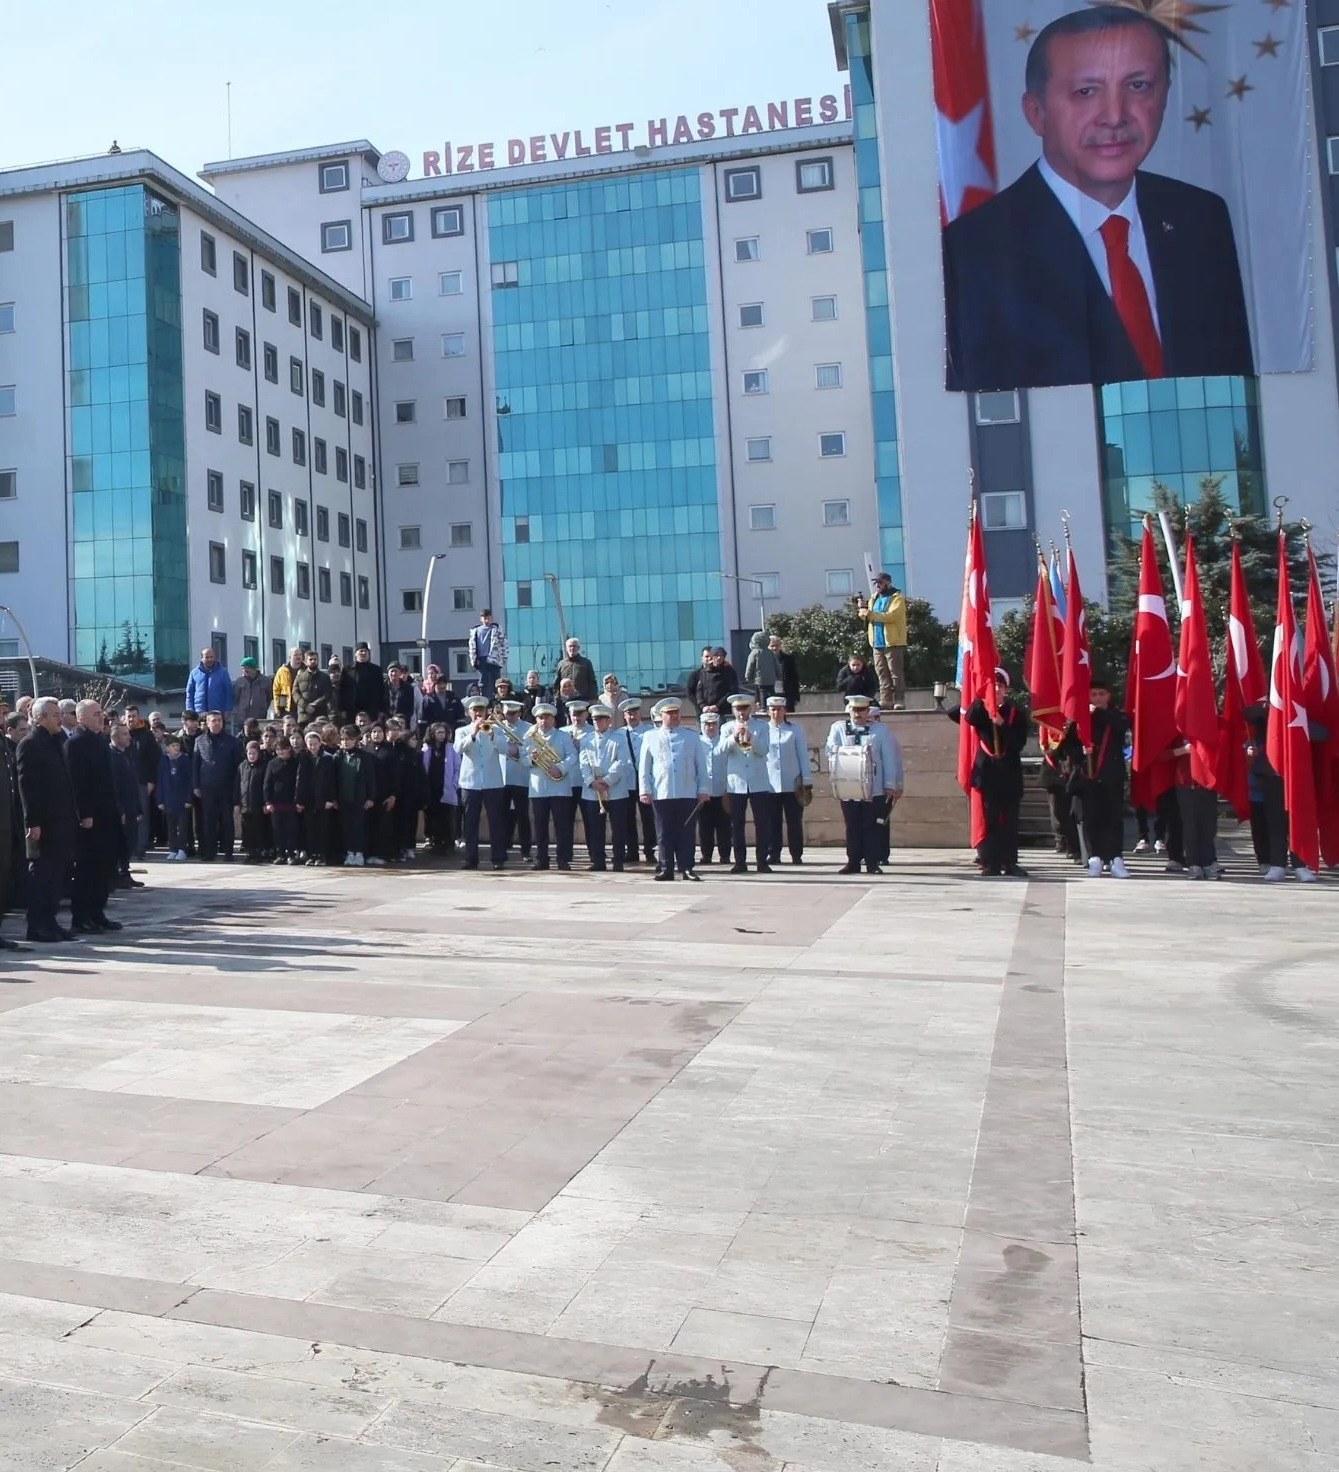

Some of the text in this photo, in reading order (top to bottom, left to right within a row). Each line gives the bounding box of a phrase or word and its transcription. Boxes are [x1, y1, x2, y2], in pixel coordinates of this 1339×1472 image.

[423, 141, 495, 177] RİZE
[508, 122, 634, 166] DEVLET
[648, 84, 853, 146] HASTANESİ
